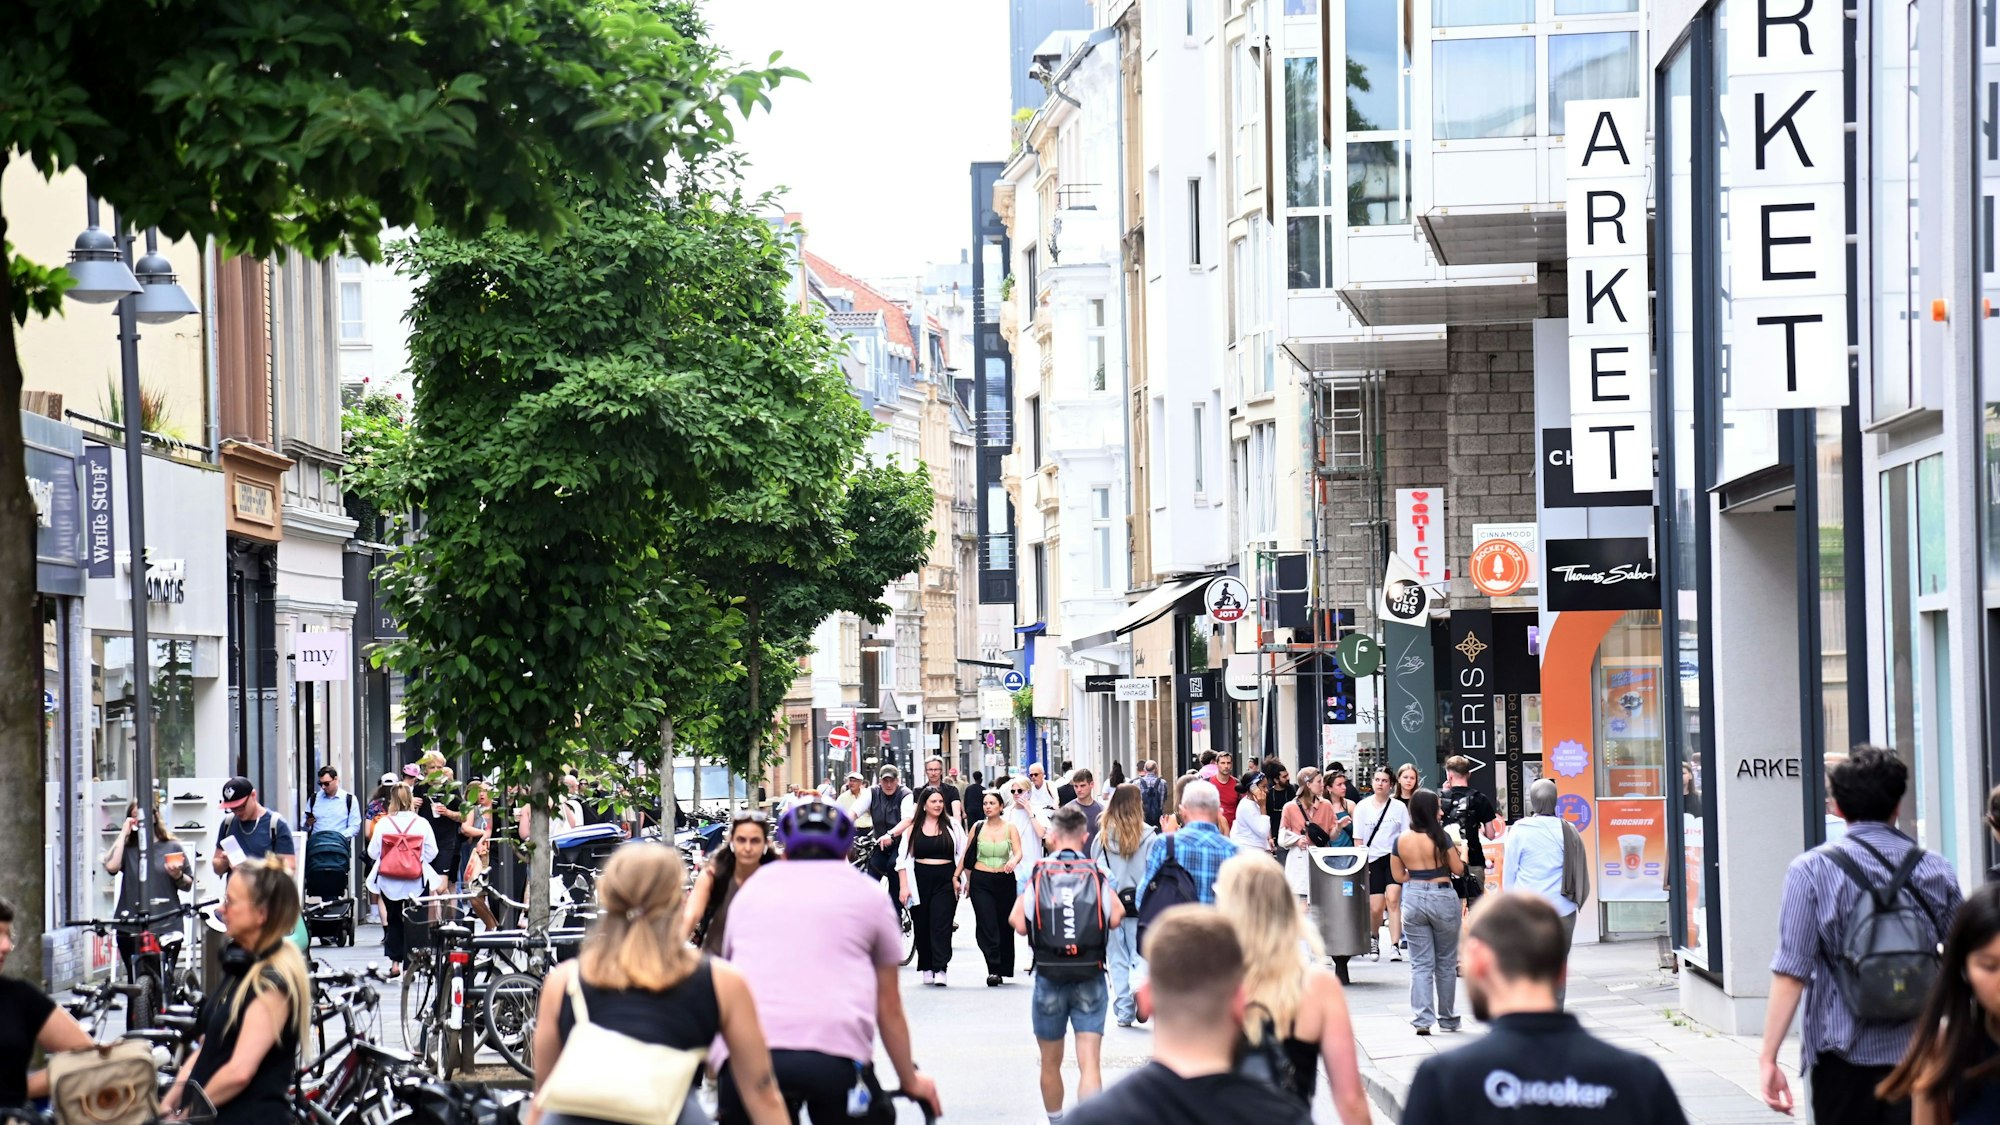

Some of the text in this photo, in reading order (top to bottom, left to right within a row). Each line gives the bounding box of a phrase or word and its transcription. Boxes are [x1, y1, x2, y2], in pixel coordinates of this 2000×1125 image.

[1755, 0, 1823, 392] RKET
[1581, 111, 1635, 480] ARKET
[1475, 544, 1522, 562] ROCKET RICE
[1552, 563, 1656, 585] Thomas Sabo
[146, 576, 184, 604] amaris
[1218, 610, 1239, 618] JOTT
[1392, 602, 1417, 615] URS
[302, 649, 334, 667] my
[1507, 693, 1518, 711] be
[1460, 667, 1487, 773] VERIS
[1508, 715, 1519, 743] true
[1509, 747, 1519, 761] to
[1737, 758, 1803, 778] ARKE
